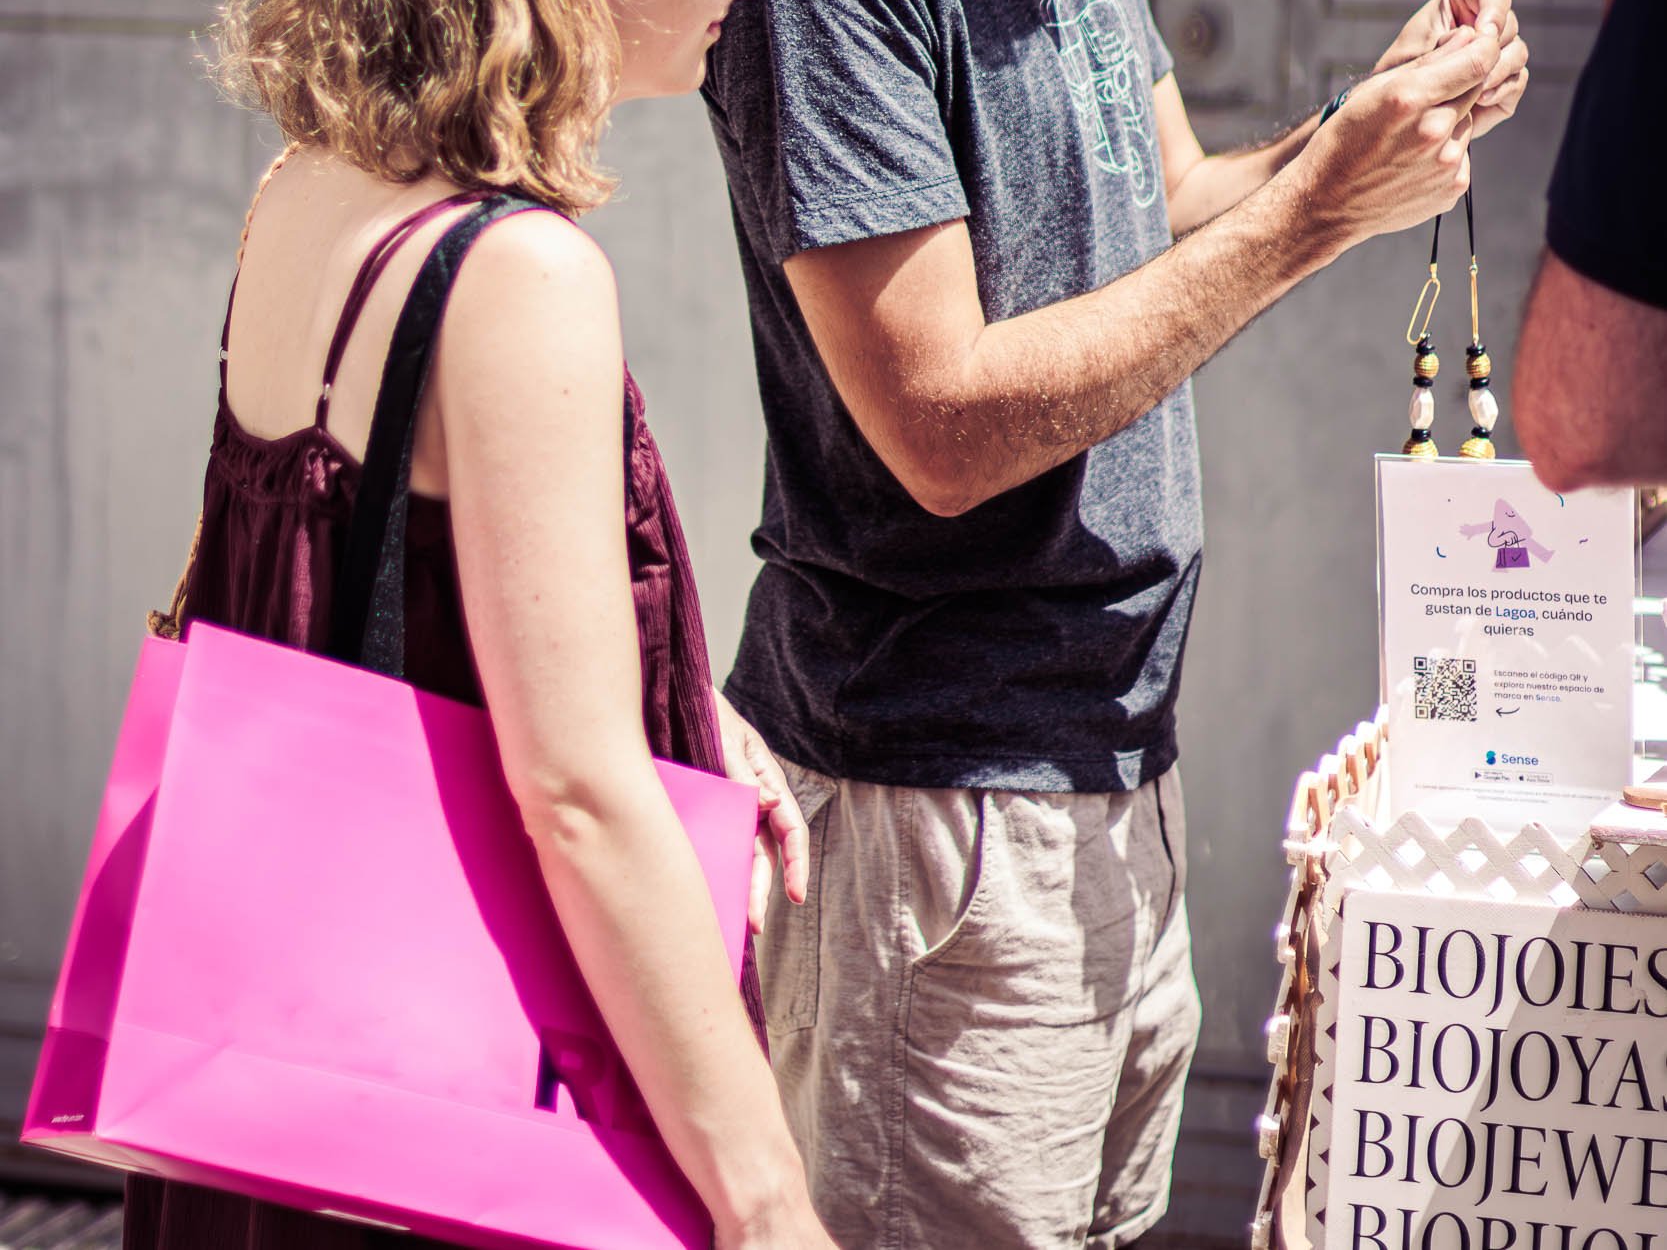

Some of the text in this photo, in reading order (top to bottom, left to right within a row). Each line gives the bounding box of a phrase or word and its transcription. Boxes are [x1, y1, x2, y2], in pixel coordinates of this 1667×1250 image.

[1410, 583, 1608, 605] Compra los productos que te
[1425, 604, 1593, 622] gustan de Lagoa, cuándo
[1483, 623, 1535, 637] quieras
[1530, 671, 1538, 679] el
[1494, 691, 1522, 700] marca
[1526, 683, 1558, 691] nuestro
[1559, 684, 1592, 693] espacio
[1593, 686, 1605, 694] de
[1501, 753, 1539, 766] Sense
[1359, 921, 1667, 1018] BIOJOIES
[1354, 1014, 1667, 1113] BIOJOYA
